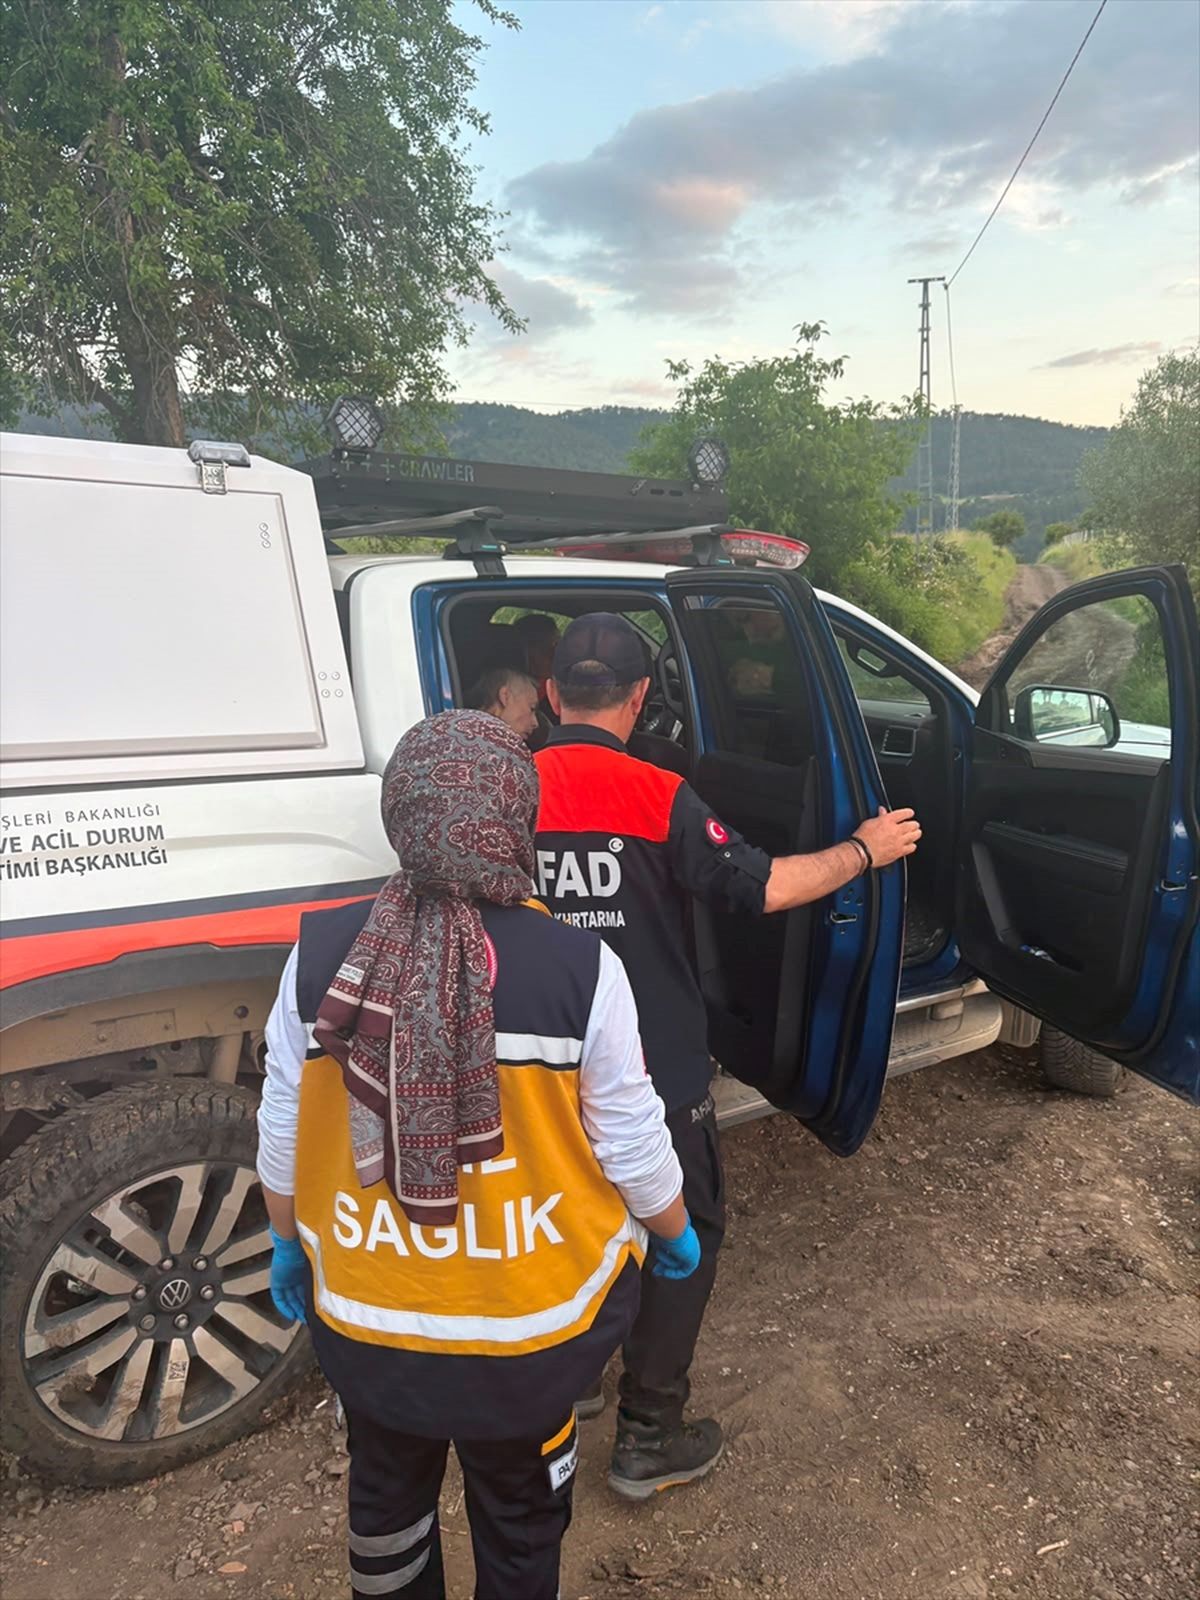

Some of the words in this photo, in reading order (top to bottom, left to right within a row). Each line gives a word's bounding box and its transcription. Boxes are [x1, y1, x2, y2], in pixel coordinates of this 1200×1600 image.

[399, 459, 475, 482] CRAWLER
[65, 804, 161, 823] BAKANLIĞI
[31, 829, 79, 851] ACİL
[86, 825, 165, 847] DURUM
[45, 846, 168, 876] BAŞKANLIĞI
[531, 850, 622, 898] FAD
